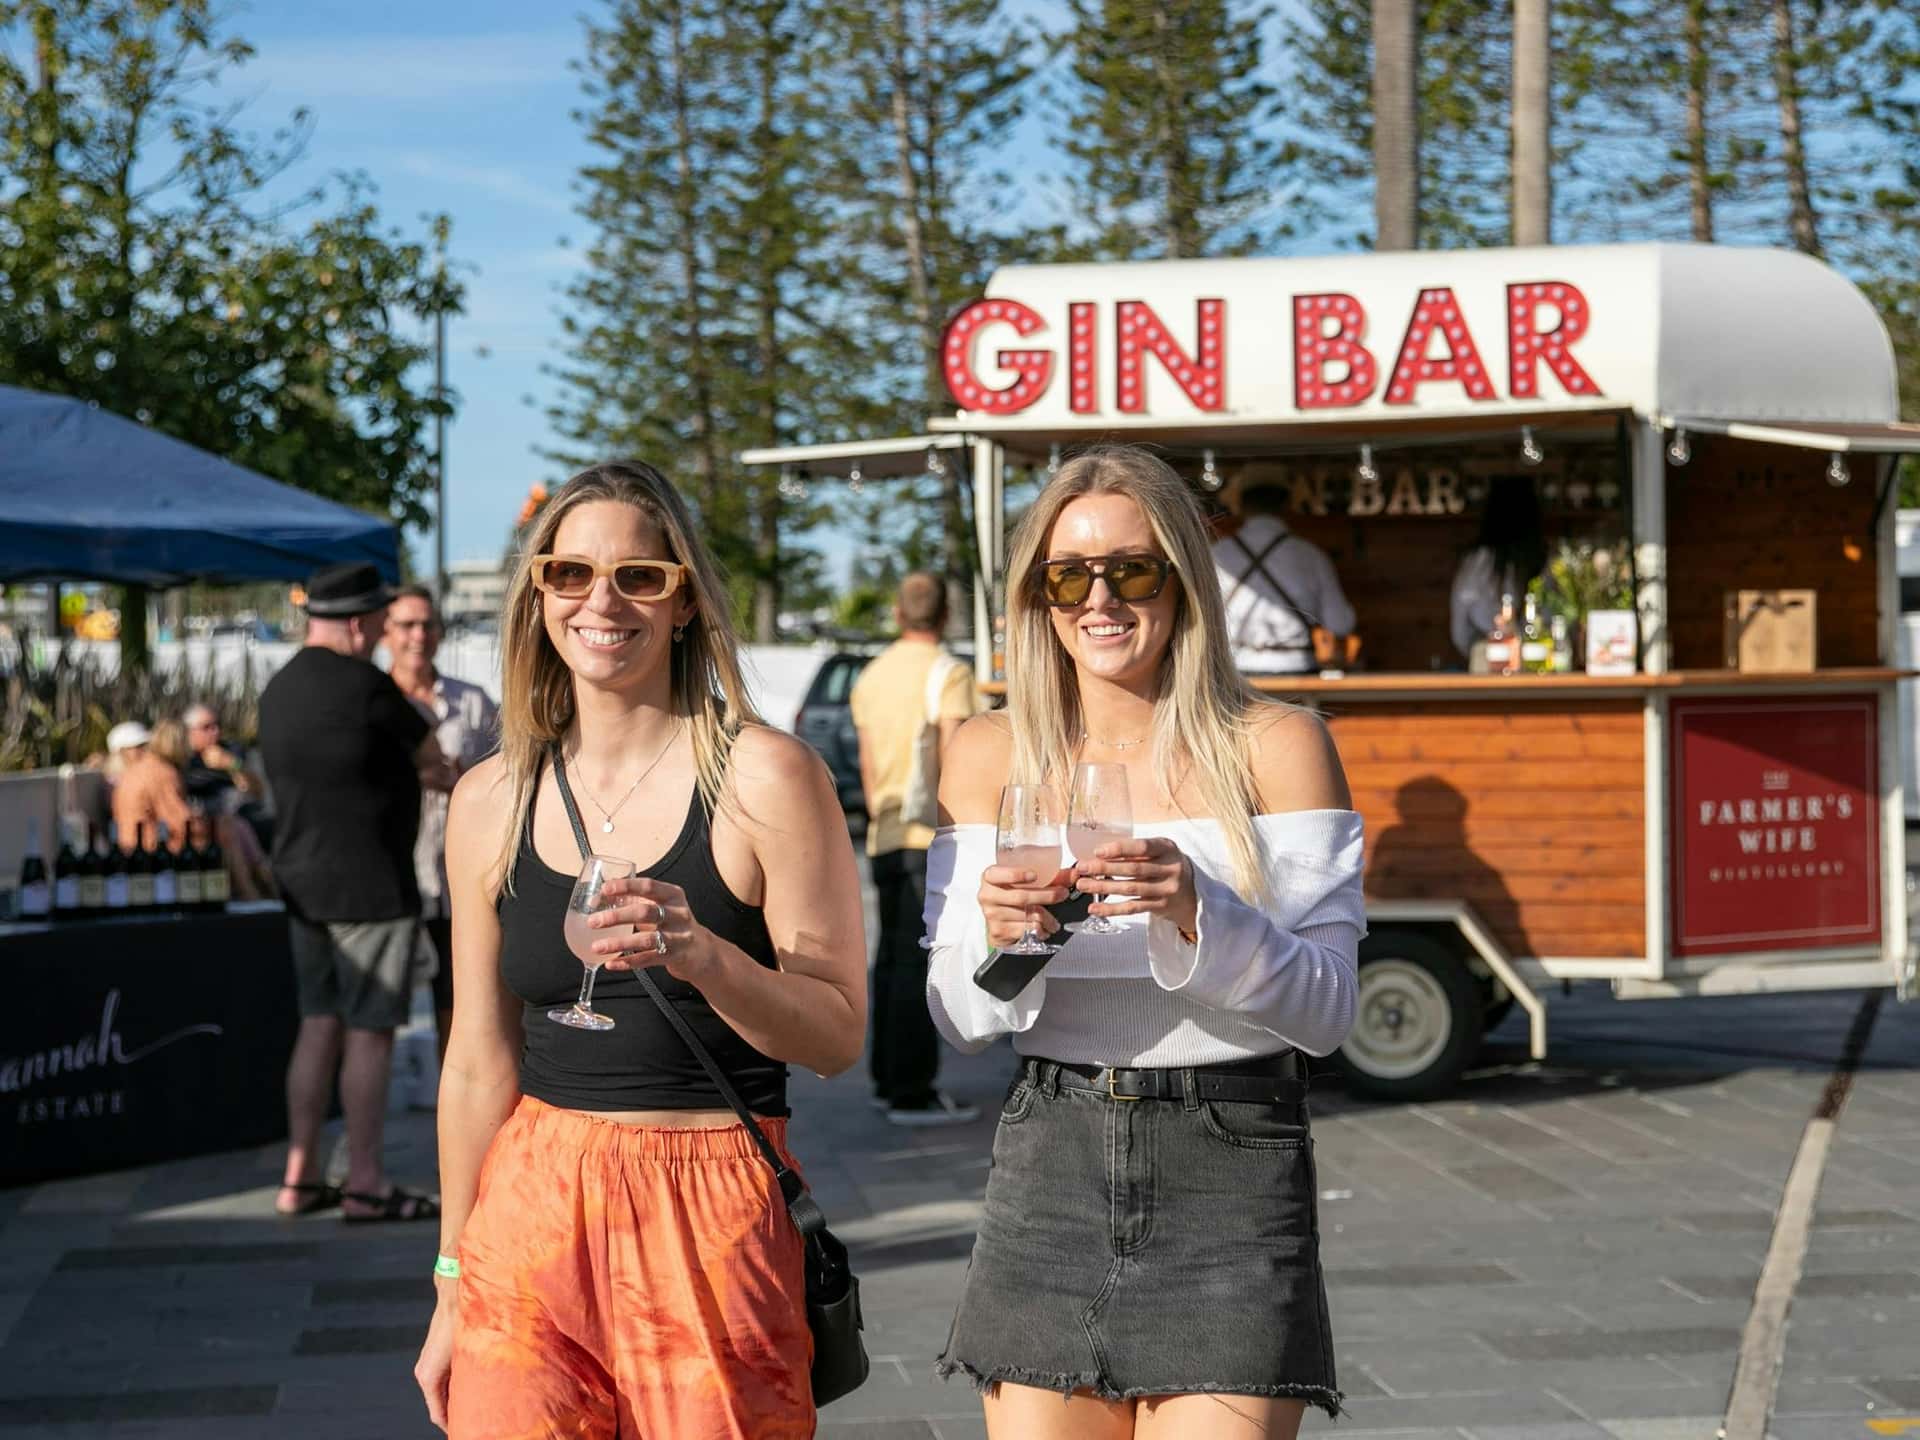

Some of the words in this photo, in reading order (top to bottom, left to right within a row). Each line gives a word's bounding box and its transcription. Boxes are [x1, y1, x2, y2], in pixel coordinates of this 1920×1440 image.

[943, 298, 1225, 415] GIN
[1292, 281, 1603, 409] BAR
[1347, 466, 1465, 516] BAR
